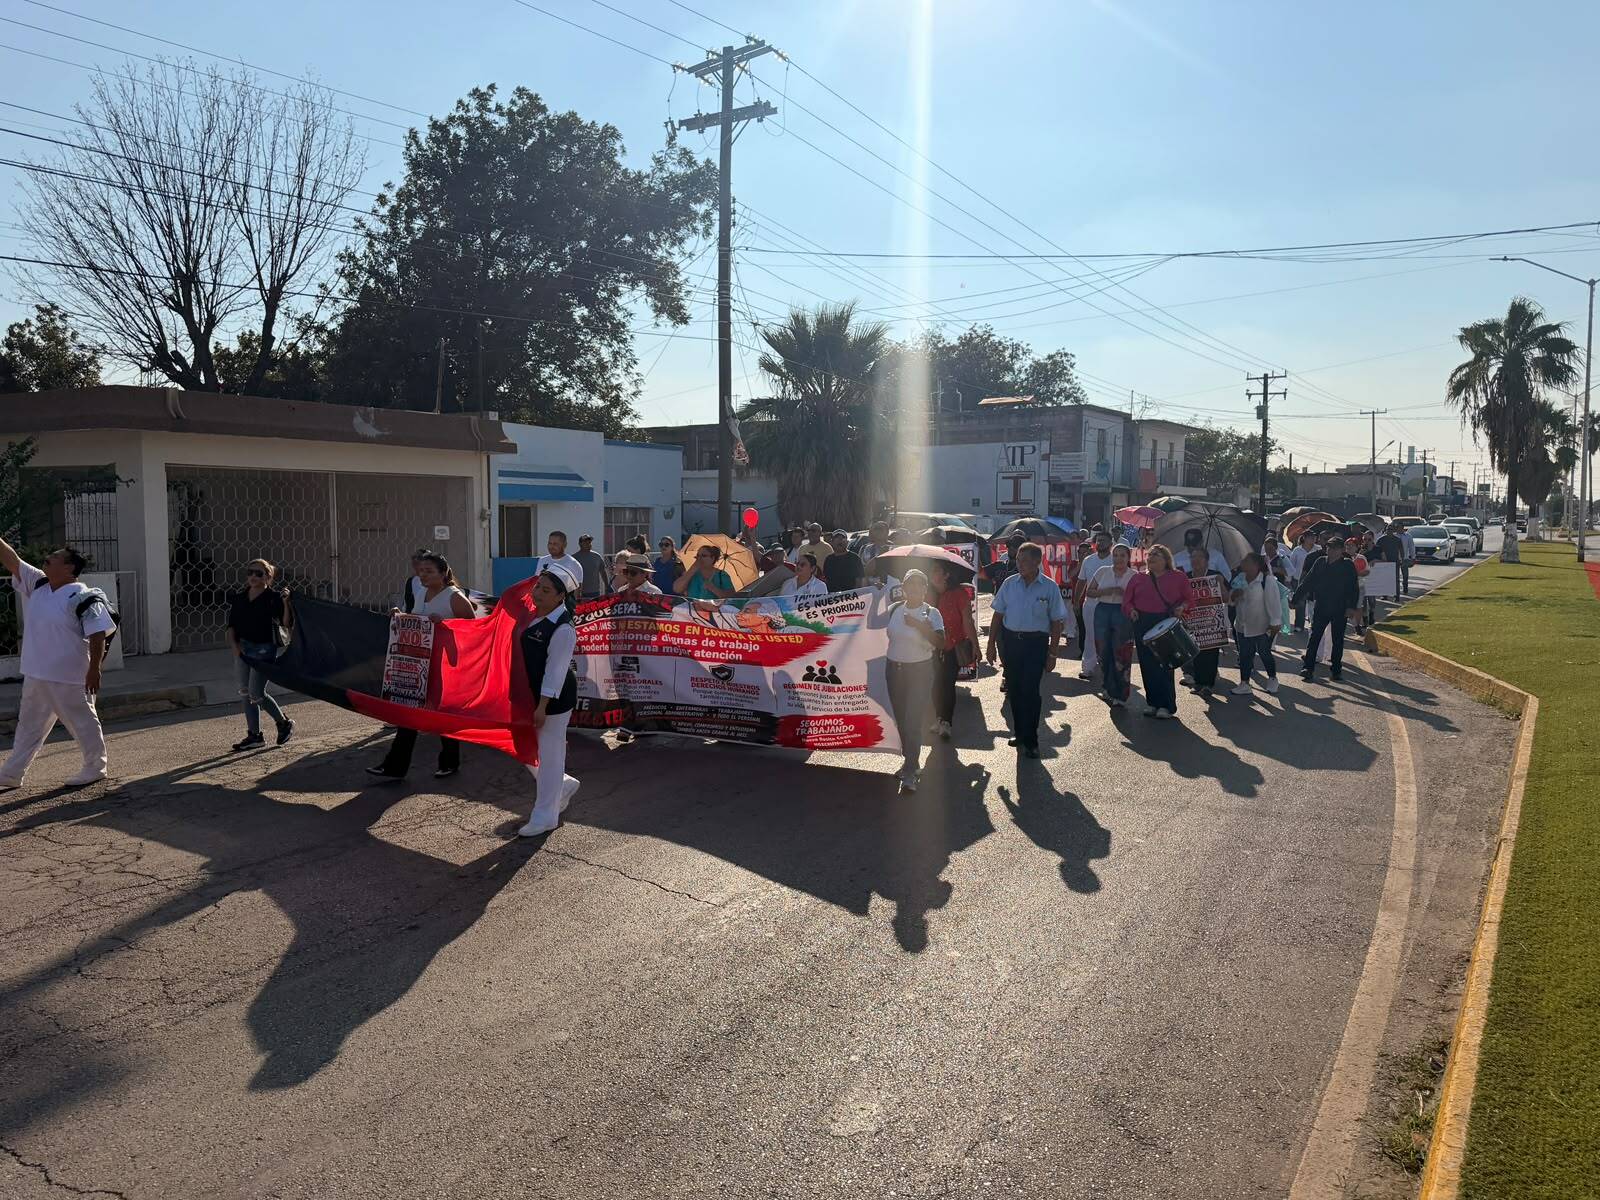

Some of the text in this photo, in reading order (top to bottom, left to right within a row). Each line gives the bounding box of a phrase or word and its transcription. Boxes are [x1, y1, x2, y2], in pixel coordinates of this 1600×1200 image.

[999, 444, 1036, 467] ATP
[585, 606, 612, 621] QUE
[612, 602, 642, 615] SEPA:
[797, 592, 859, 613] ES NUESTRA
[806, 601, 866, 620] ES PRIORIDAD
[399, 629, 421, 647] NO
[627, 620, 680, 634] ESTAMOS
[685, 625, 700, 636] EN
[703, 628, 746, 641] CONTRA
[747, 634, 763, 642] DE
[765, 635, 804, 644] USTED
[581, 642, 610, 653] poderle
[636, 644, 659, 653] una
[694, 648, 743, 661] atención
[590, 633, 604, 643] por
[661, 633, 698, 646] dignas
[701, 637, 716, 648] de
[719, 639, 760, 653] trabajo
[813, 683, 820, 691] DE
[821, 684, 869, 693] JUBILACIONES
[796, 724, 855, 736] TRABAJANDO
[800, 718, 845, 728] SEGUIMOS
